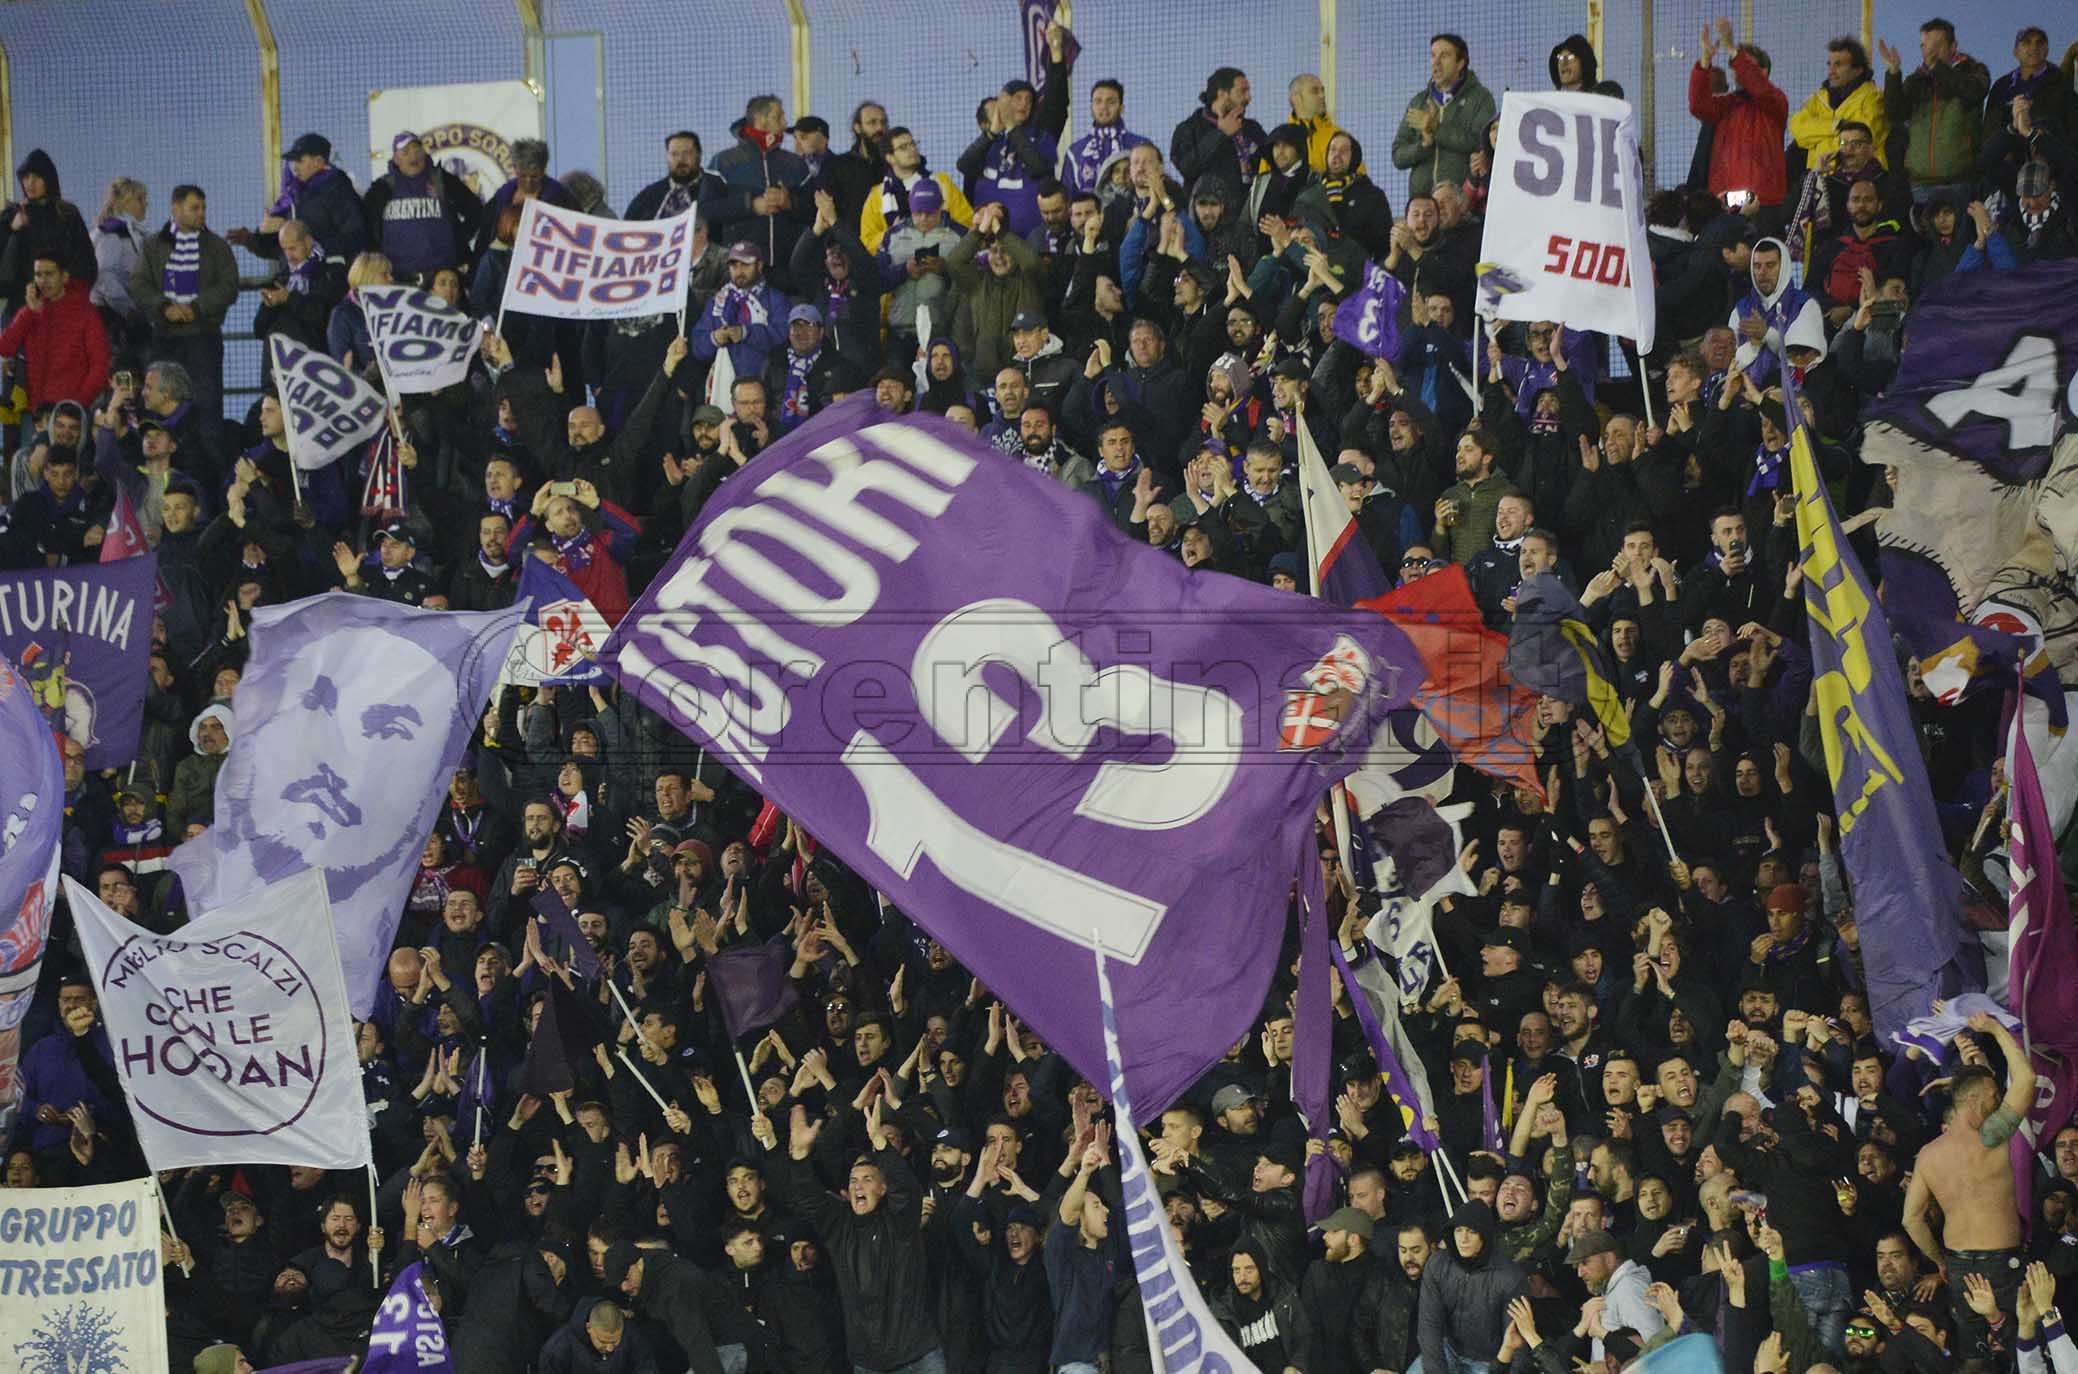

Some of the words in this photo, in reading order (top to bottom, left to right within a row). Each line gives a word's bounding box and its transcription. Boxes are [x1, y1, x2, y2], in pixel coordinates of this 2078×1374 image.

[529, 239, 683, 279] TIFIAMO
[371, 312, 479, 343] FIAMO
[283, 374, 360, 434] IAMO
[839, 597, 1244, 966] 13
[200, 941, 304, 997] SCALZI
[164, 985, 235, 1014] CHE
[227, 1013, 274, 1046] LE
[1, 1199, 137, 1247] GRUPPO
[0, 1248, 158, 1298] TRESSATO
